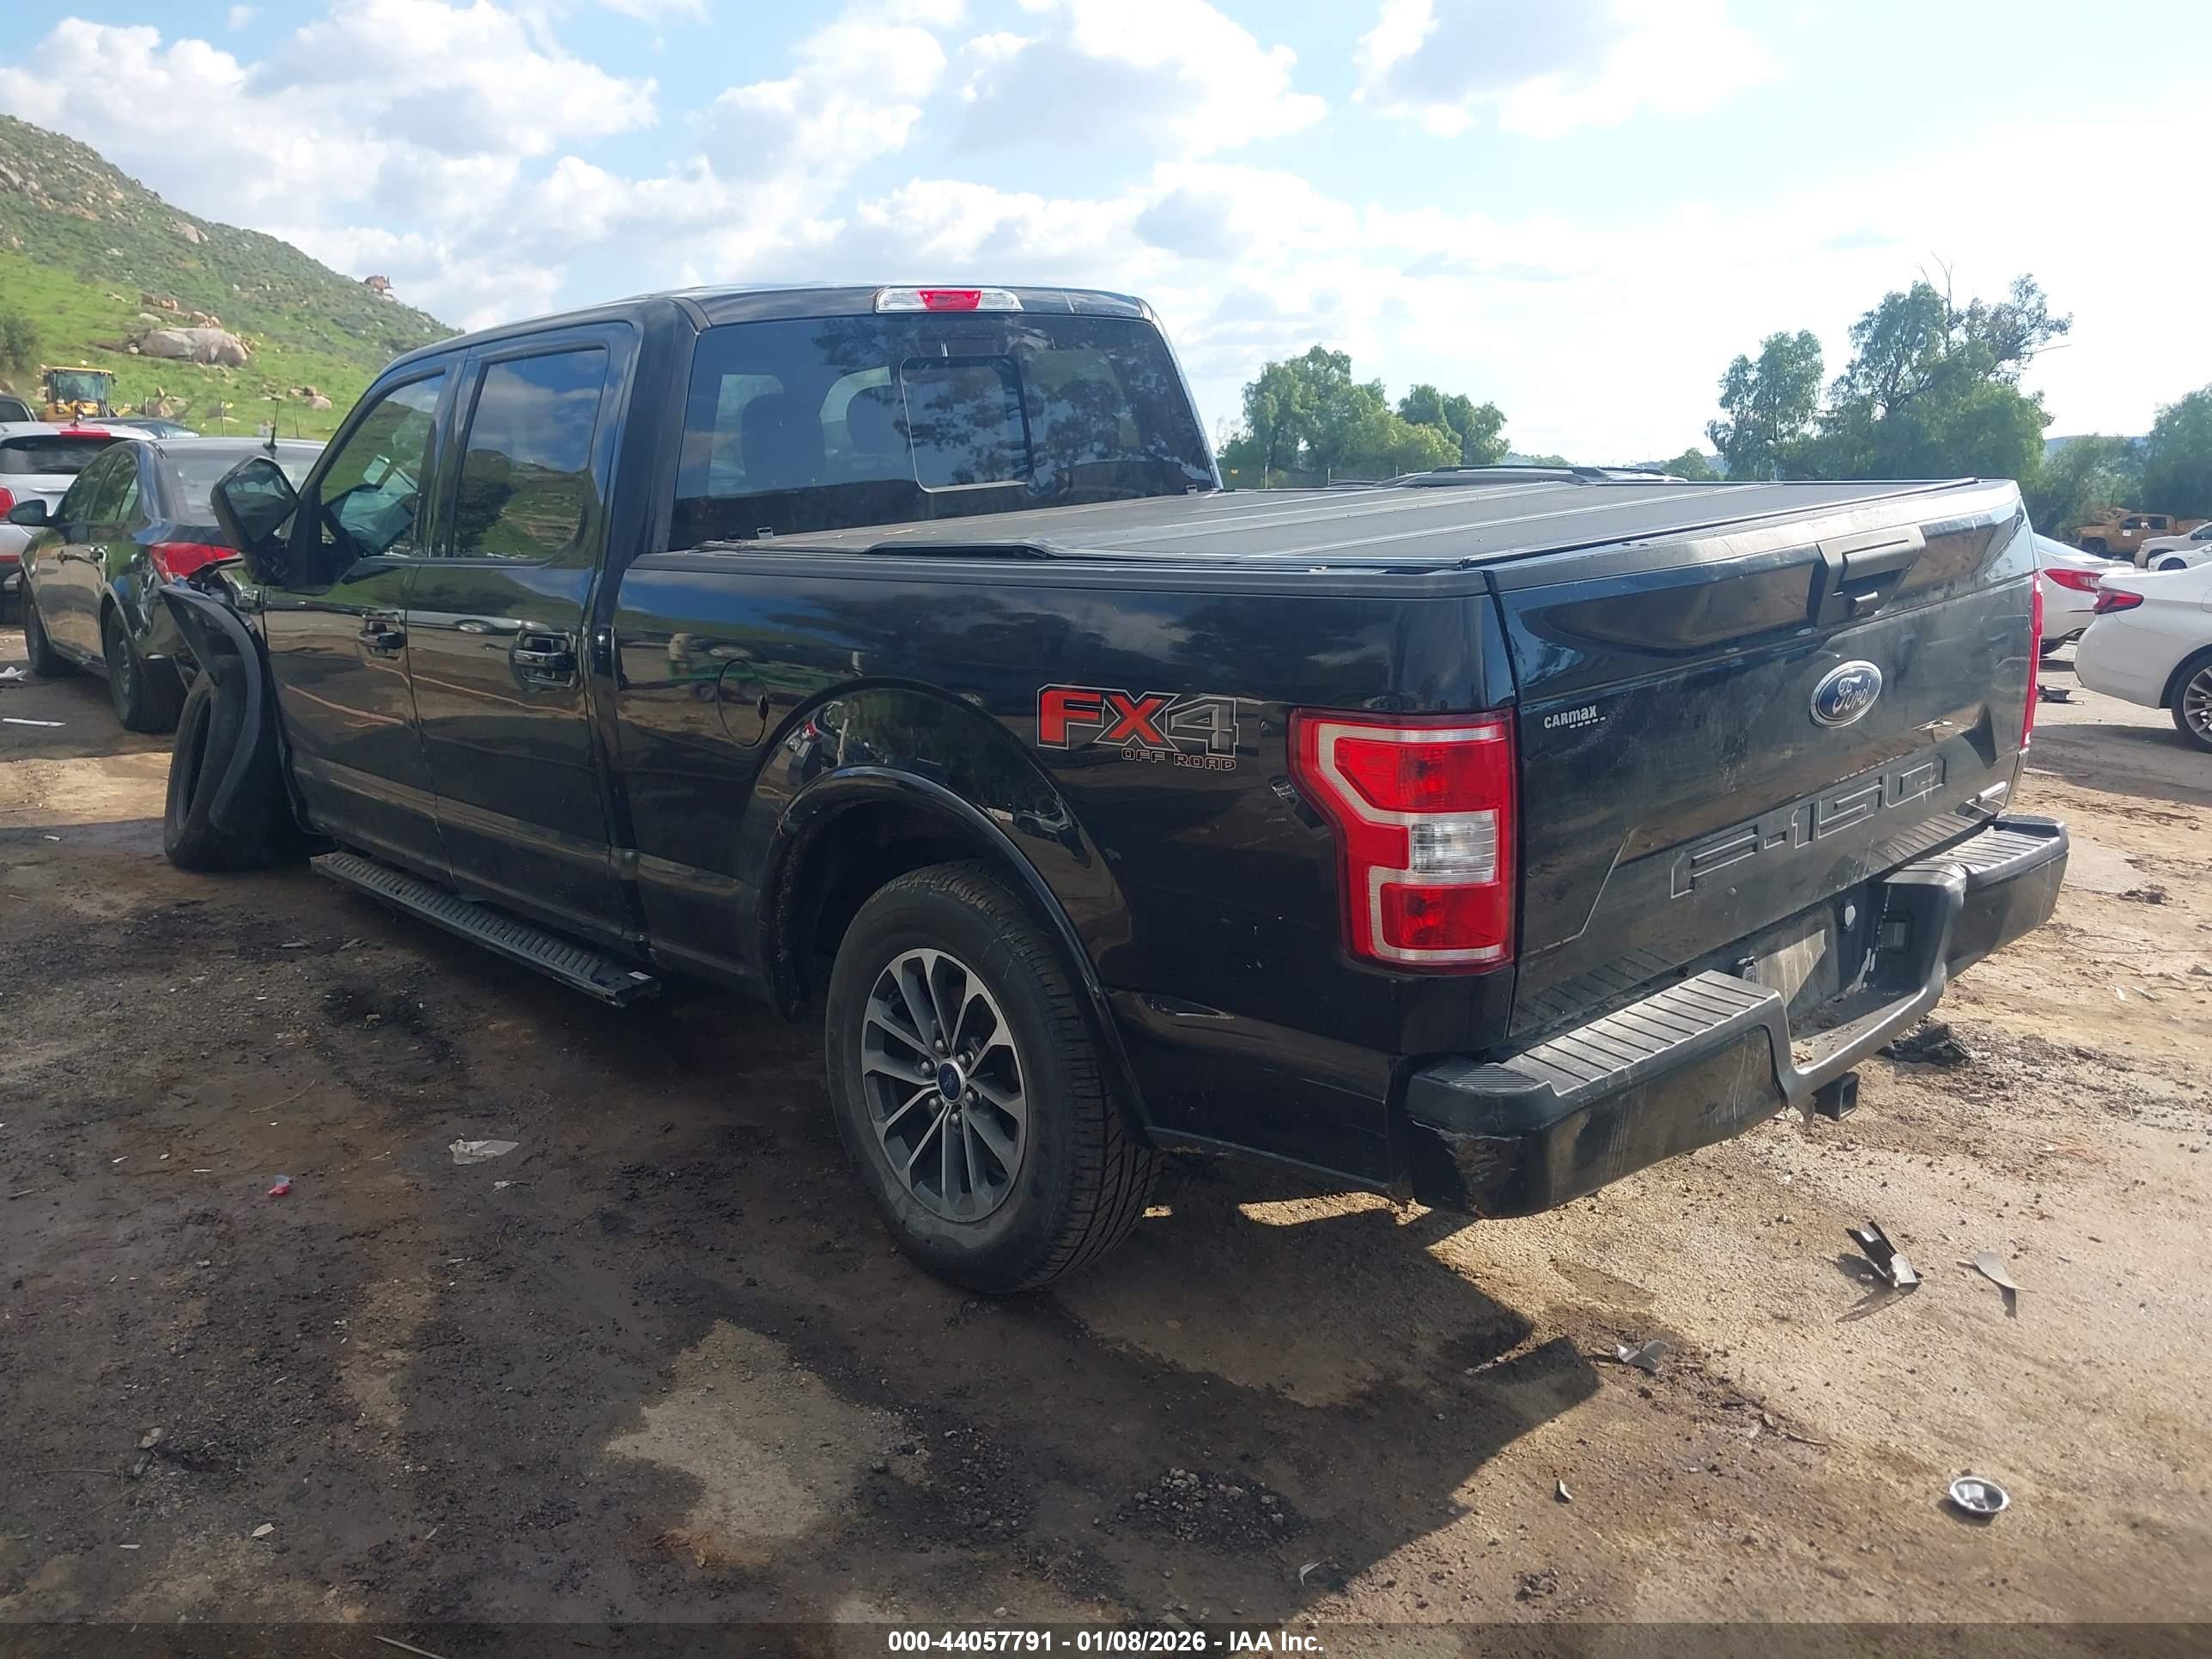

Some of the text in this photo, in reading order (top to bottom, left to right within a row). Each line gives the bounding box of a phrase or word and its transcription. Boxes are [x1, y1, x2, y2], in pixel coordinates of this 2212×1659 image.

[1036, 684, 1239, 758] FX4
[1832, 674, 1871, 715] Ford
[1121, 747, 1237, 772] OFF ROAD
[1670, 752, 1948, 899] F-150
